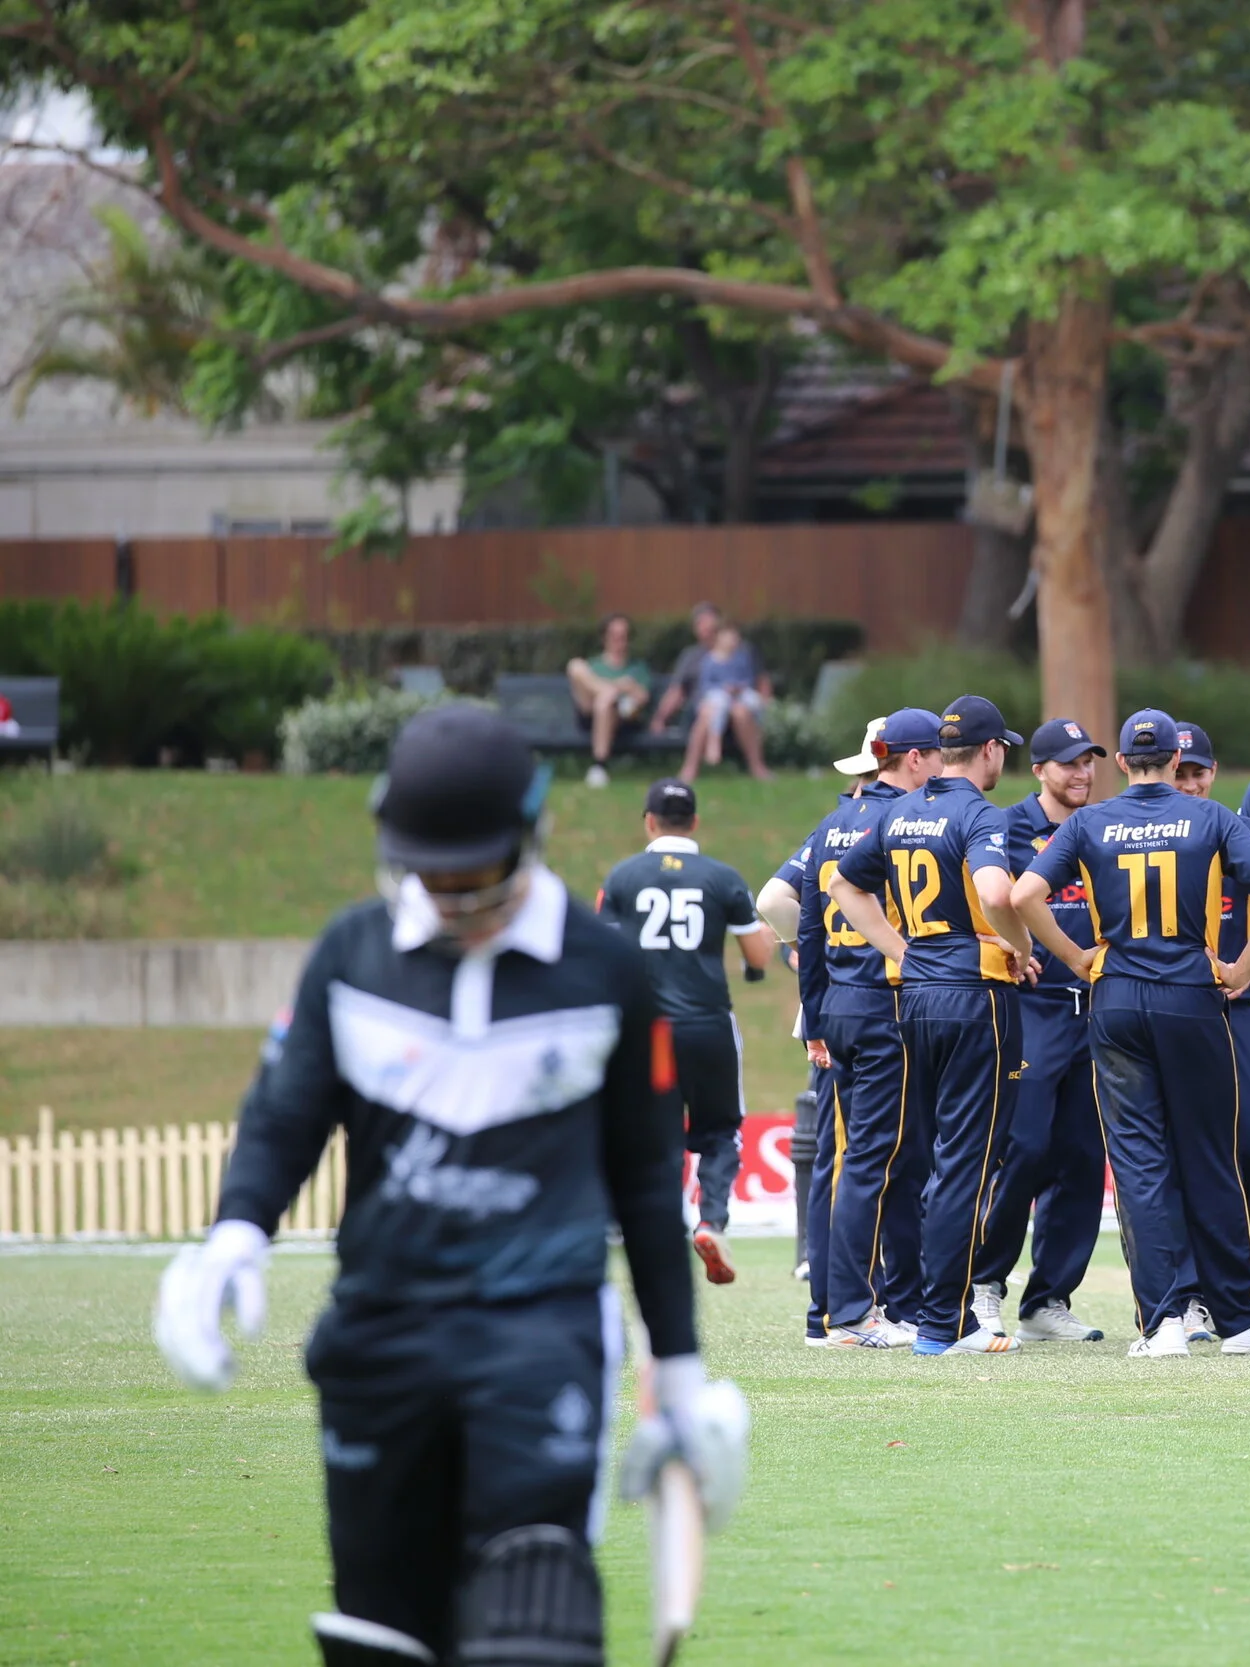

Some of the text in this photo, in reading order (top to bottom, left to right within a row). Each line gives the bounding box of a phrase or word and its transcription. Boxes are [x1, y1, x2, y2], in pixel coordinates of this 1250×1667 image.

[888, 816, 948, 837] Firetrail
[1102, 819, 1191, 843] Firetrail
[1124, 839, 1169, 849] INVESTMENTS
[890, 848, 951, 938] 12
[1117, 850, 1178, 939] 11
[636, 887, 705, 951] 25
